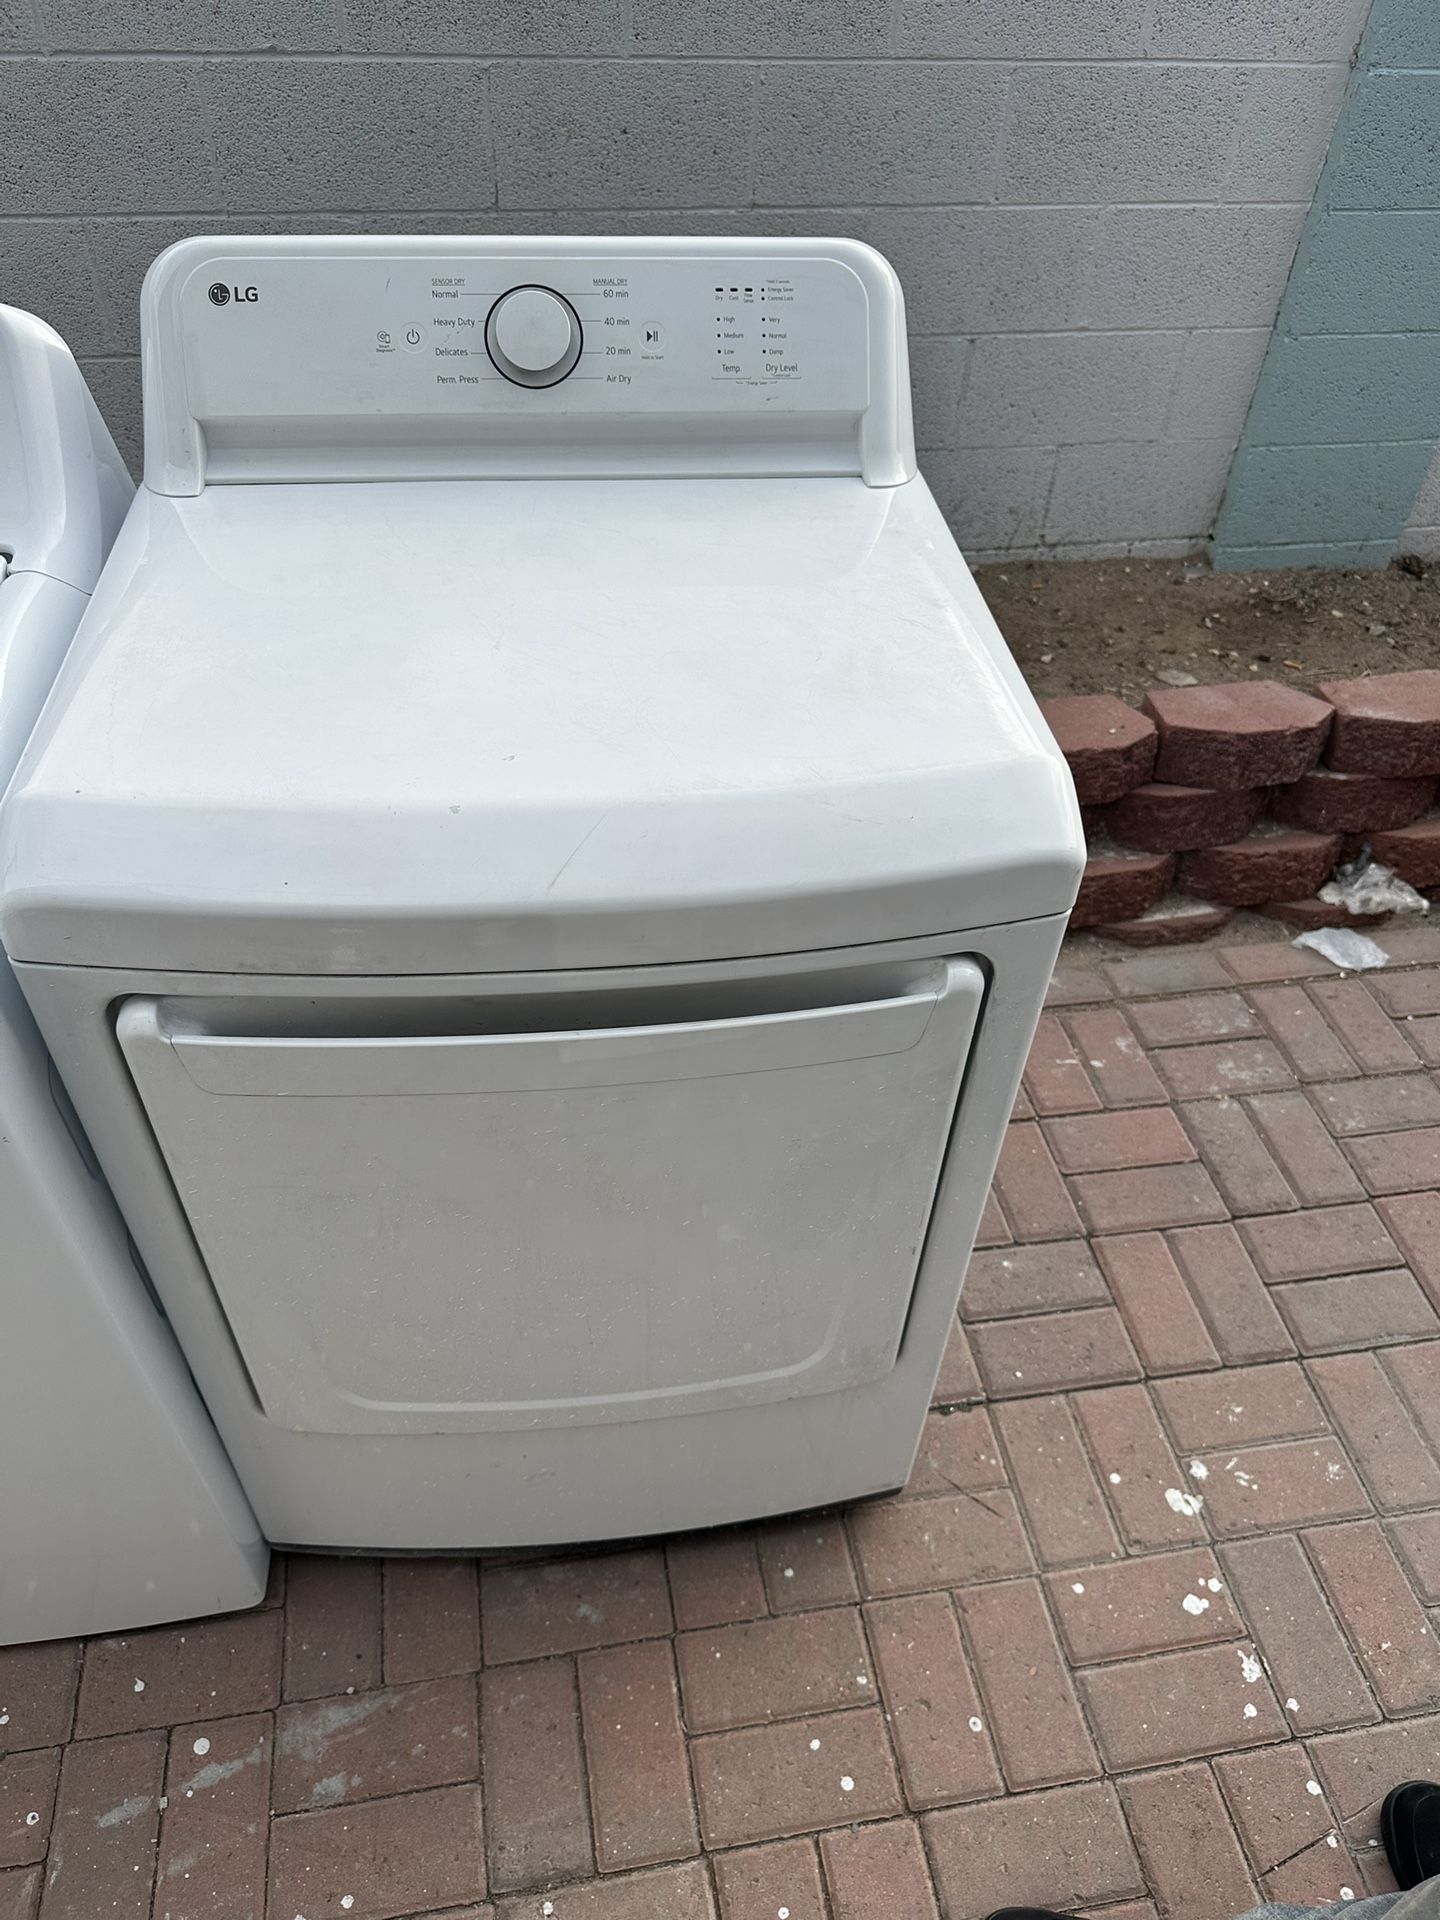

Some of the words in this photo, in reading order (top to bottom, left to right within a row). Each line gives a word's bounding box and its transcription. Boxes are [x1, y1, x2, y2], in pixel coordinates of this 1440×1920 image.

[234, 286, 258, 302] LG
[603, 290, 614, 298] 60
[616, 290, 628, 298] min
[434, 318, 456, 328] Heavy
[458, 318, 475, 328] Duty
[604, 318, 614, 326] 40
[616, 318, 630, 326] min
[436, 348, 468, 356] Delicates
[606, 346, 616, 355] 20
[618, 347, 631, 355] min
[722, 364, 742, 373] Temp.
[766, 364, 778, 373] Dry
[780, 364, 798, 372] Level
[436, 376, 458, 384] Perm.
[459, 376, 479, 384] Press
[619, 375, 632, 384] Dry
